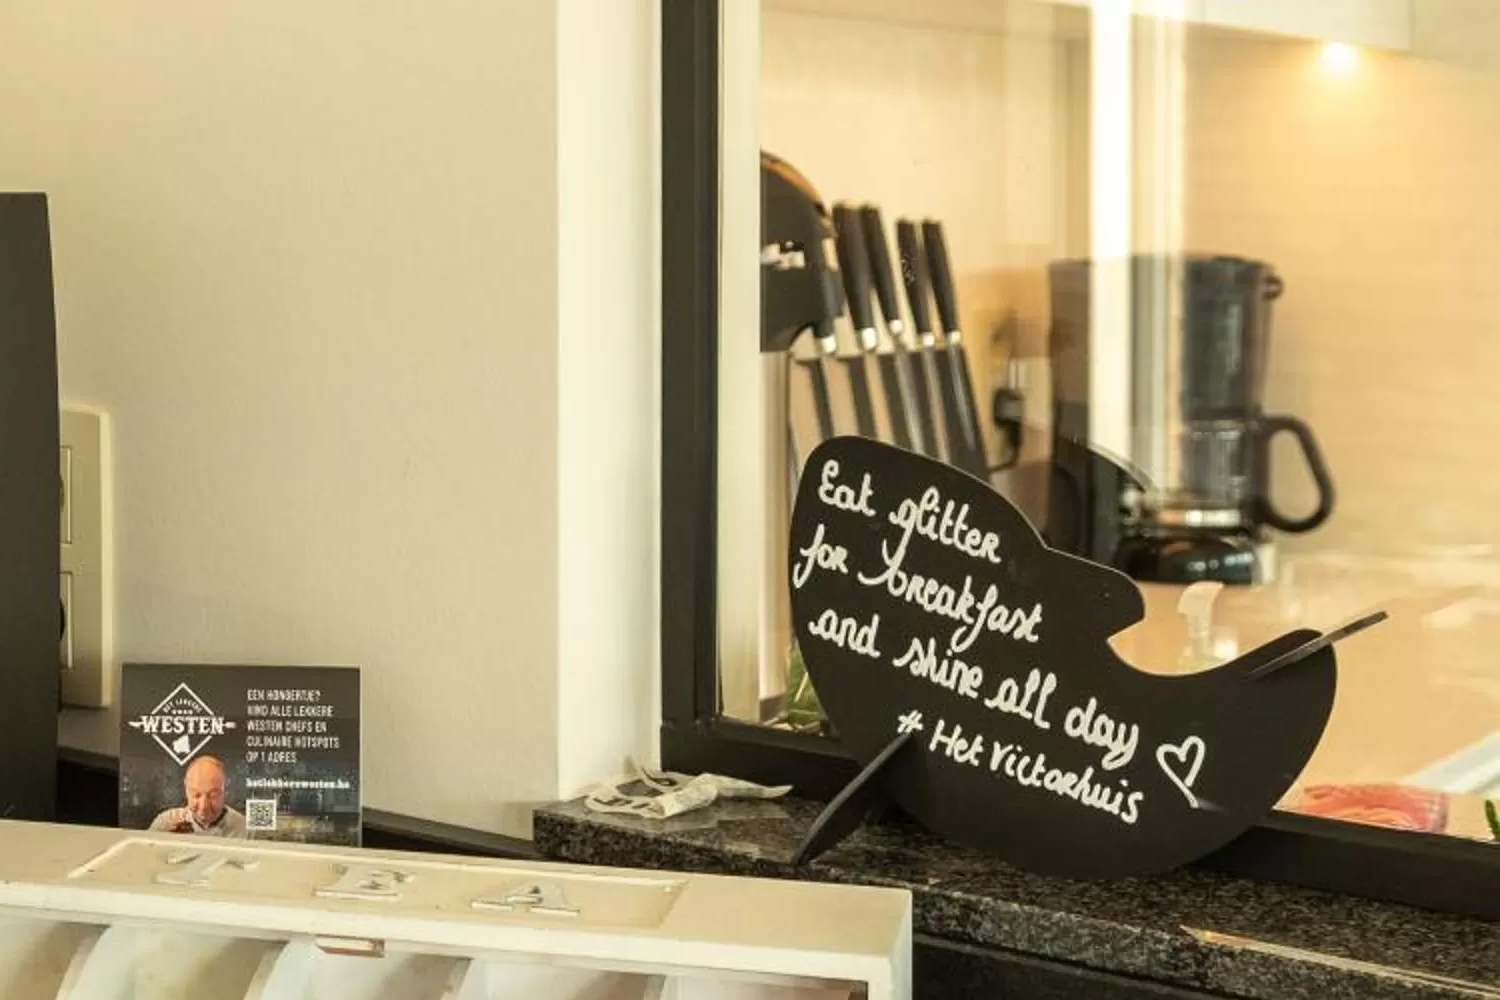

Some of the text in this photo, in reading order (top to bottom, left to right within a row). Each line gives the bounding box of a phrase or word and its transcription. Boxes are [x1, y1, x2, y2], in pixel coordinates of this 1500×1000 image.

[819, 460, 1001, 564] Eat glitter
[792, 524, 1042, 653] for breakfast
[140, 715, 225, 735] WESTEN
[808, 607, 1140, 771] and shine all day
